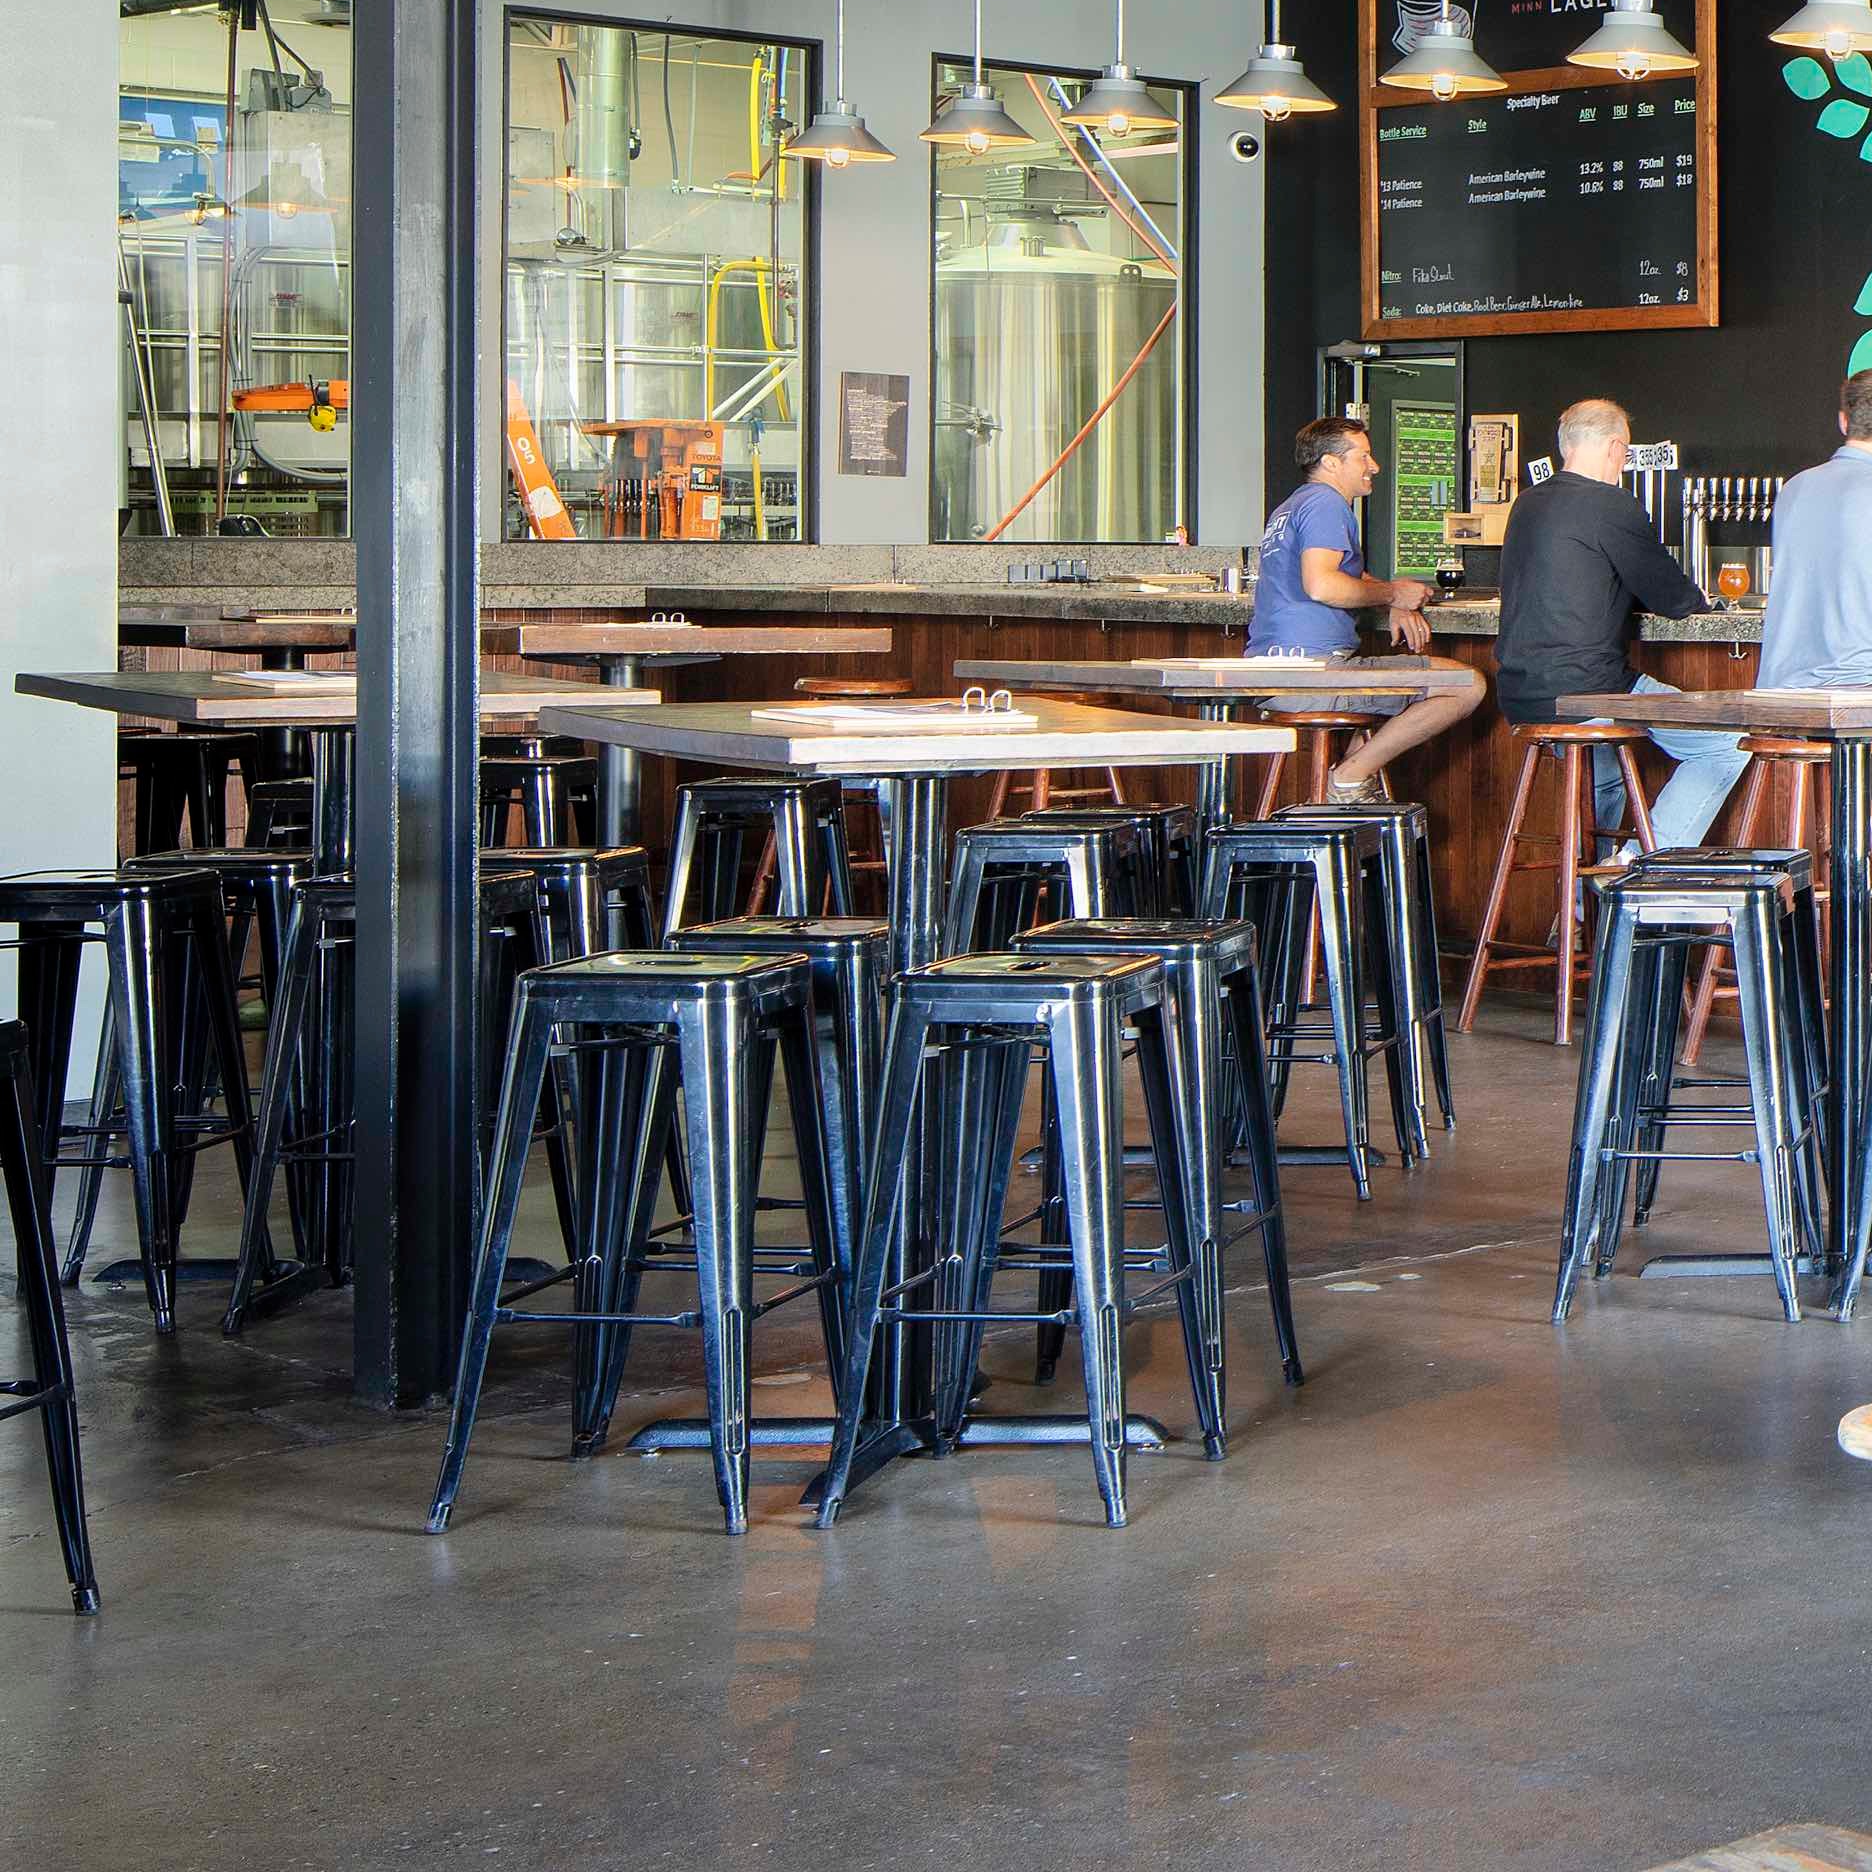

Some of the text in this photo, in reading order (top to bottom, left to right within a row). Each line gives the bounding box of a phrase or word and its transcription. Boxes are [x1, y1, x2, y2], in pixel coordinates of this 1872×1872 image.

[1511, 0, 1544, 16] MINN
[1506, 93, 1560, 112] Specialty Beer
[1379, 98, 1696, 140] Bottle Service Style ABV IBU Size Price
[1392, 179, 1424, 192] Patience
[1468, 172, 1503, 186] American
[1503, 168, 1547, 184] Barleywine
[1638, 156, 1664, 170] 750ml
[1392, 197, 1424, 211] Patience
[1468, 191, 1503, 205] American
[1503, 187, 1547, 203] Barleywine
[1638, 175, 1664, 190] 750ml
[1677, 286, 1689, 302] $3
[1533, 462, 1551, 480] 98
